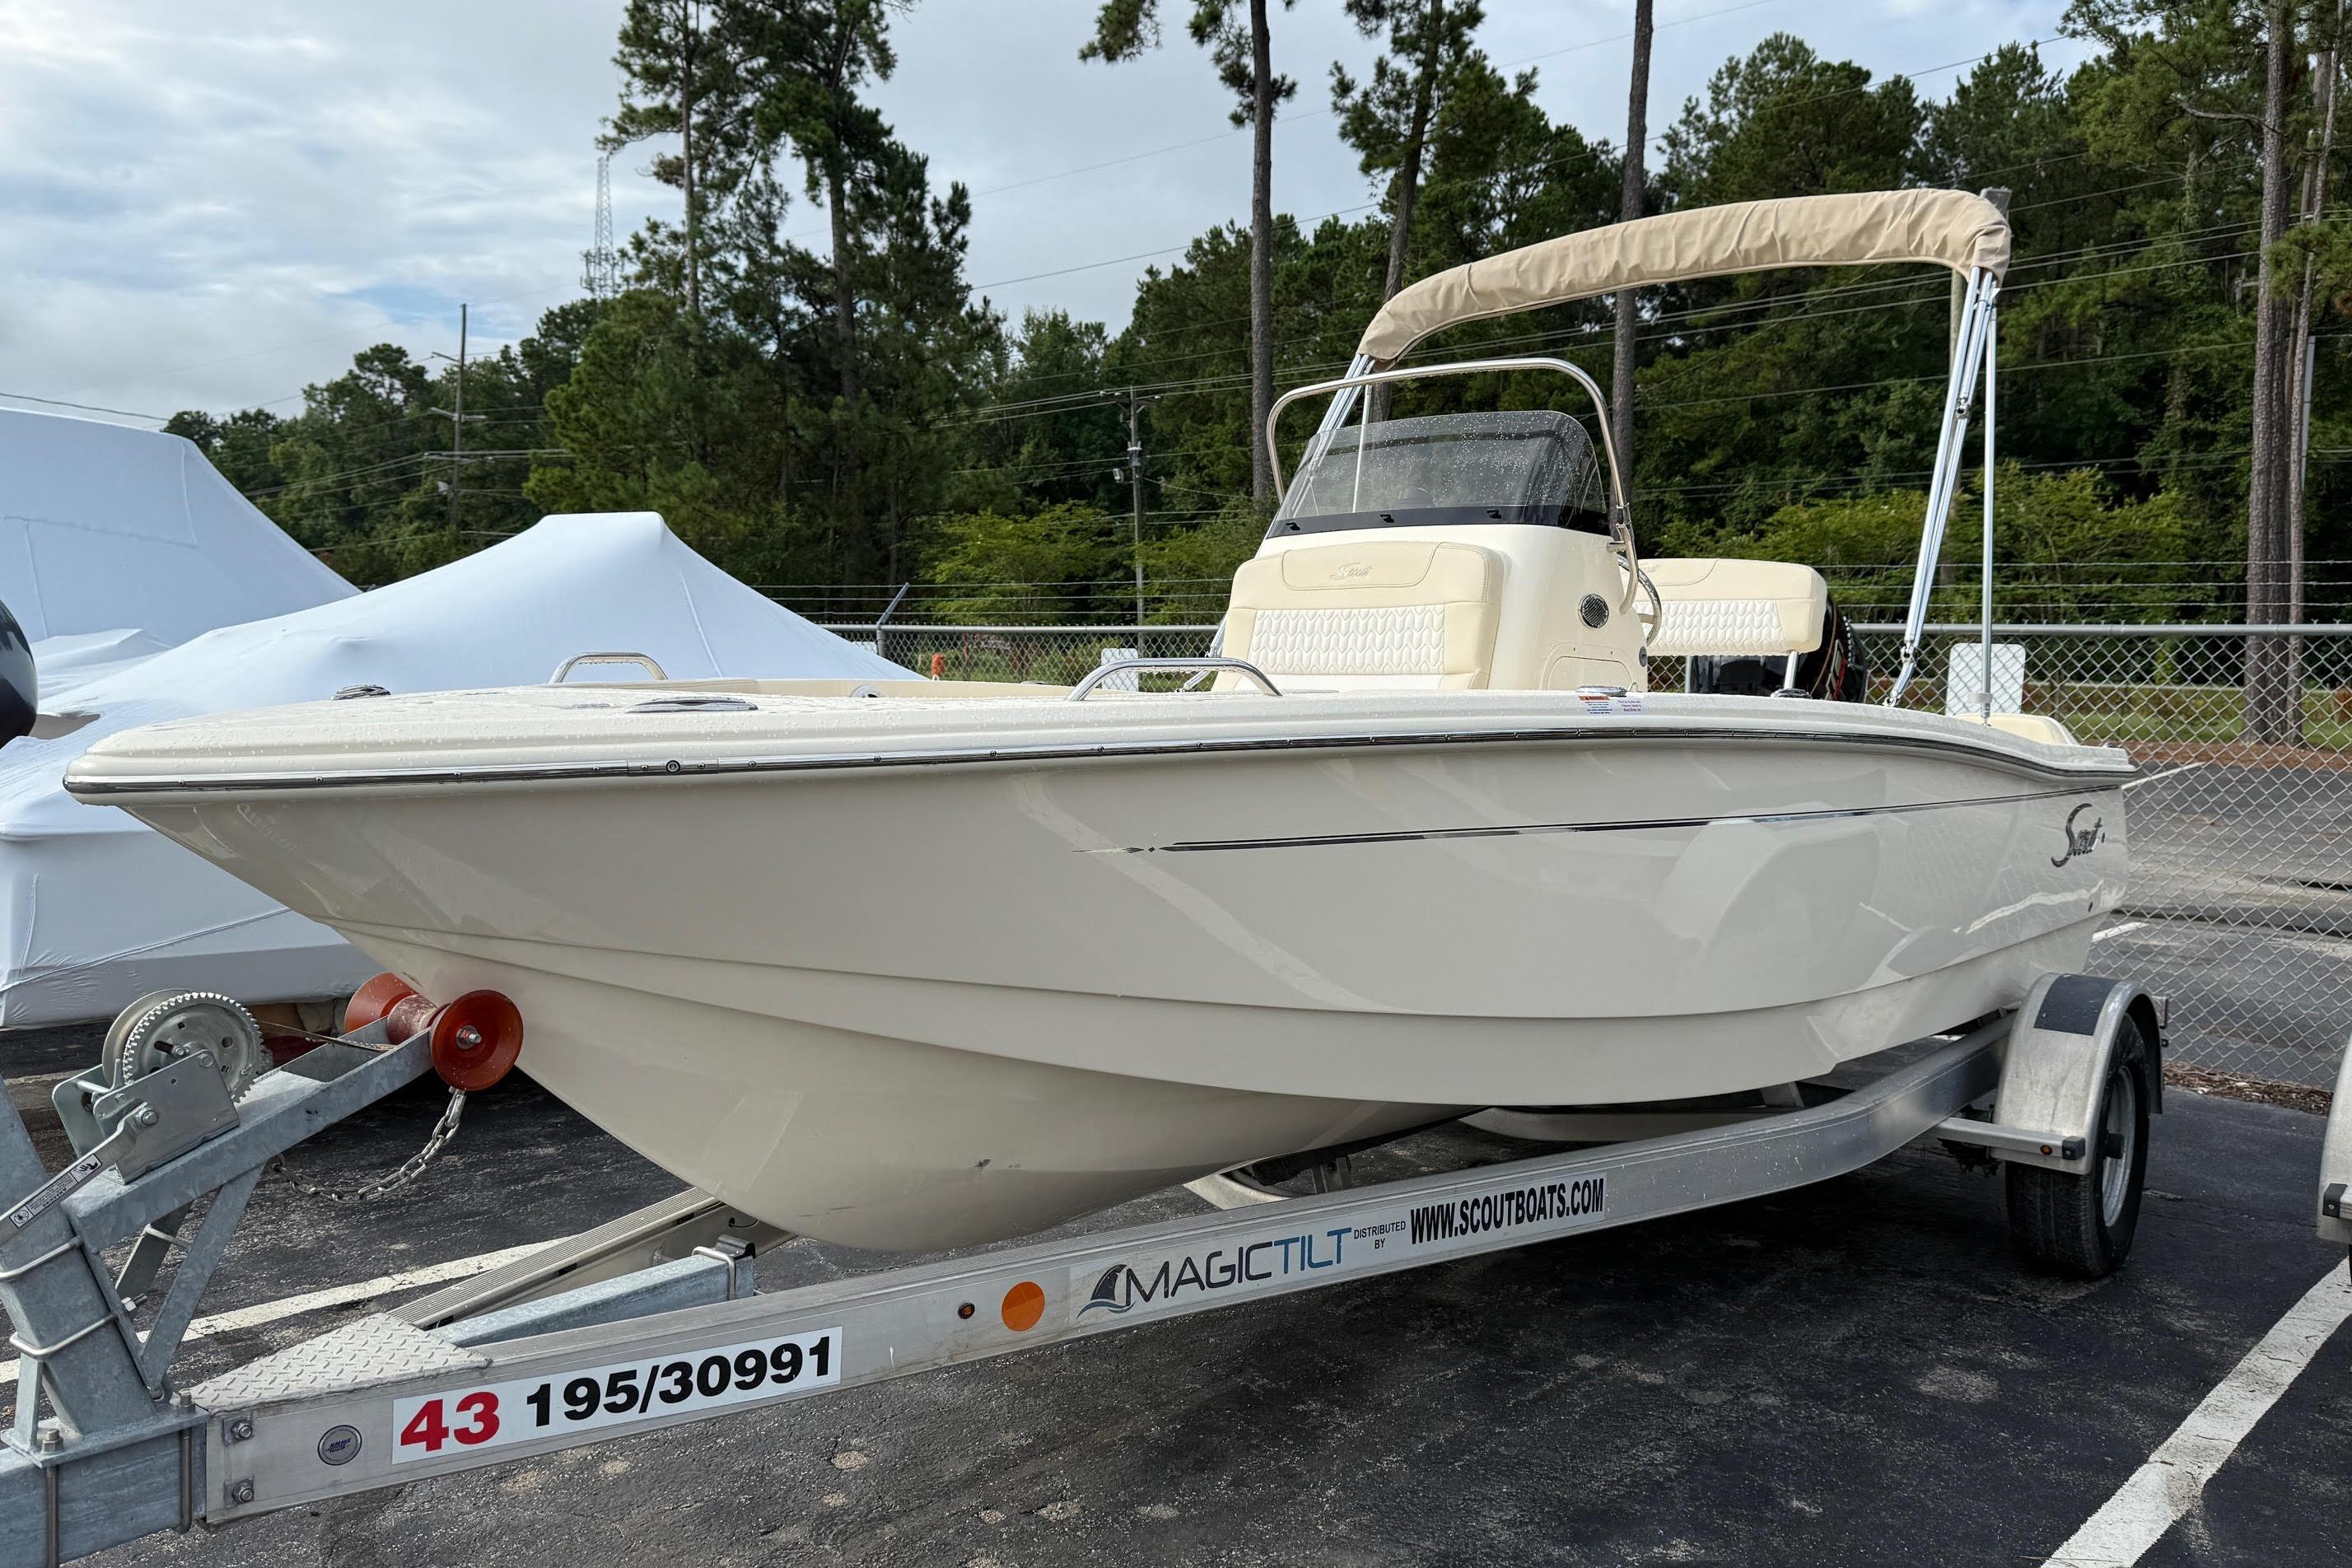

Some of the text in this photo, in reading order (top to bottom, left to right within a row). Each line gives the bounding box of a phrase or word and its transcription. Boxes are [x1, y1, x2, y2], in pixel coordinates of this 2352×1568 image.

[1354, 1220, 1407, 1239] DISTRIBUTED
[1374, 1238, 1386, 1249] BY
[1410, 1178, 1604, 1245] WWW.SCOUTBOATS.COM
[1126, 1227, 1352, 1307] MAGICTILT
[400, 1336, 831, 1452] 43 195/30991
